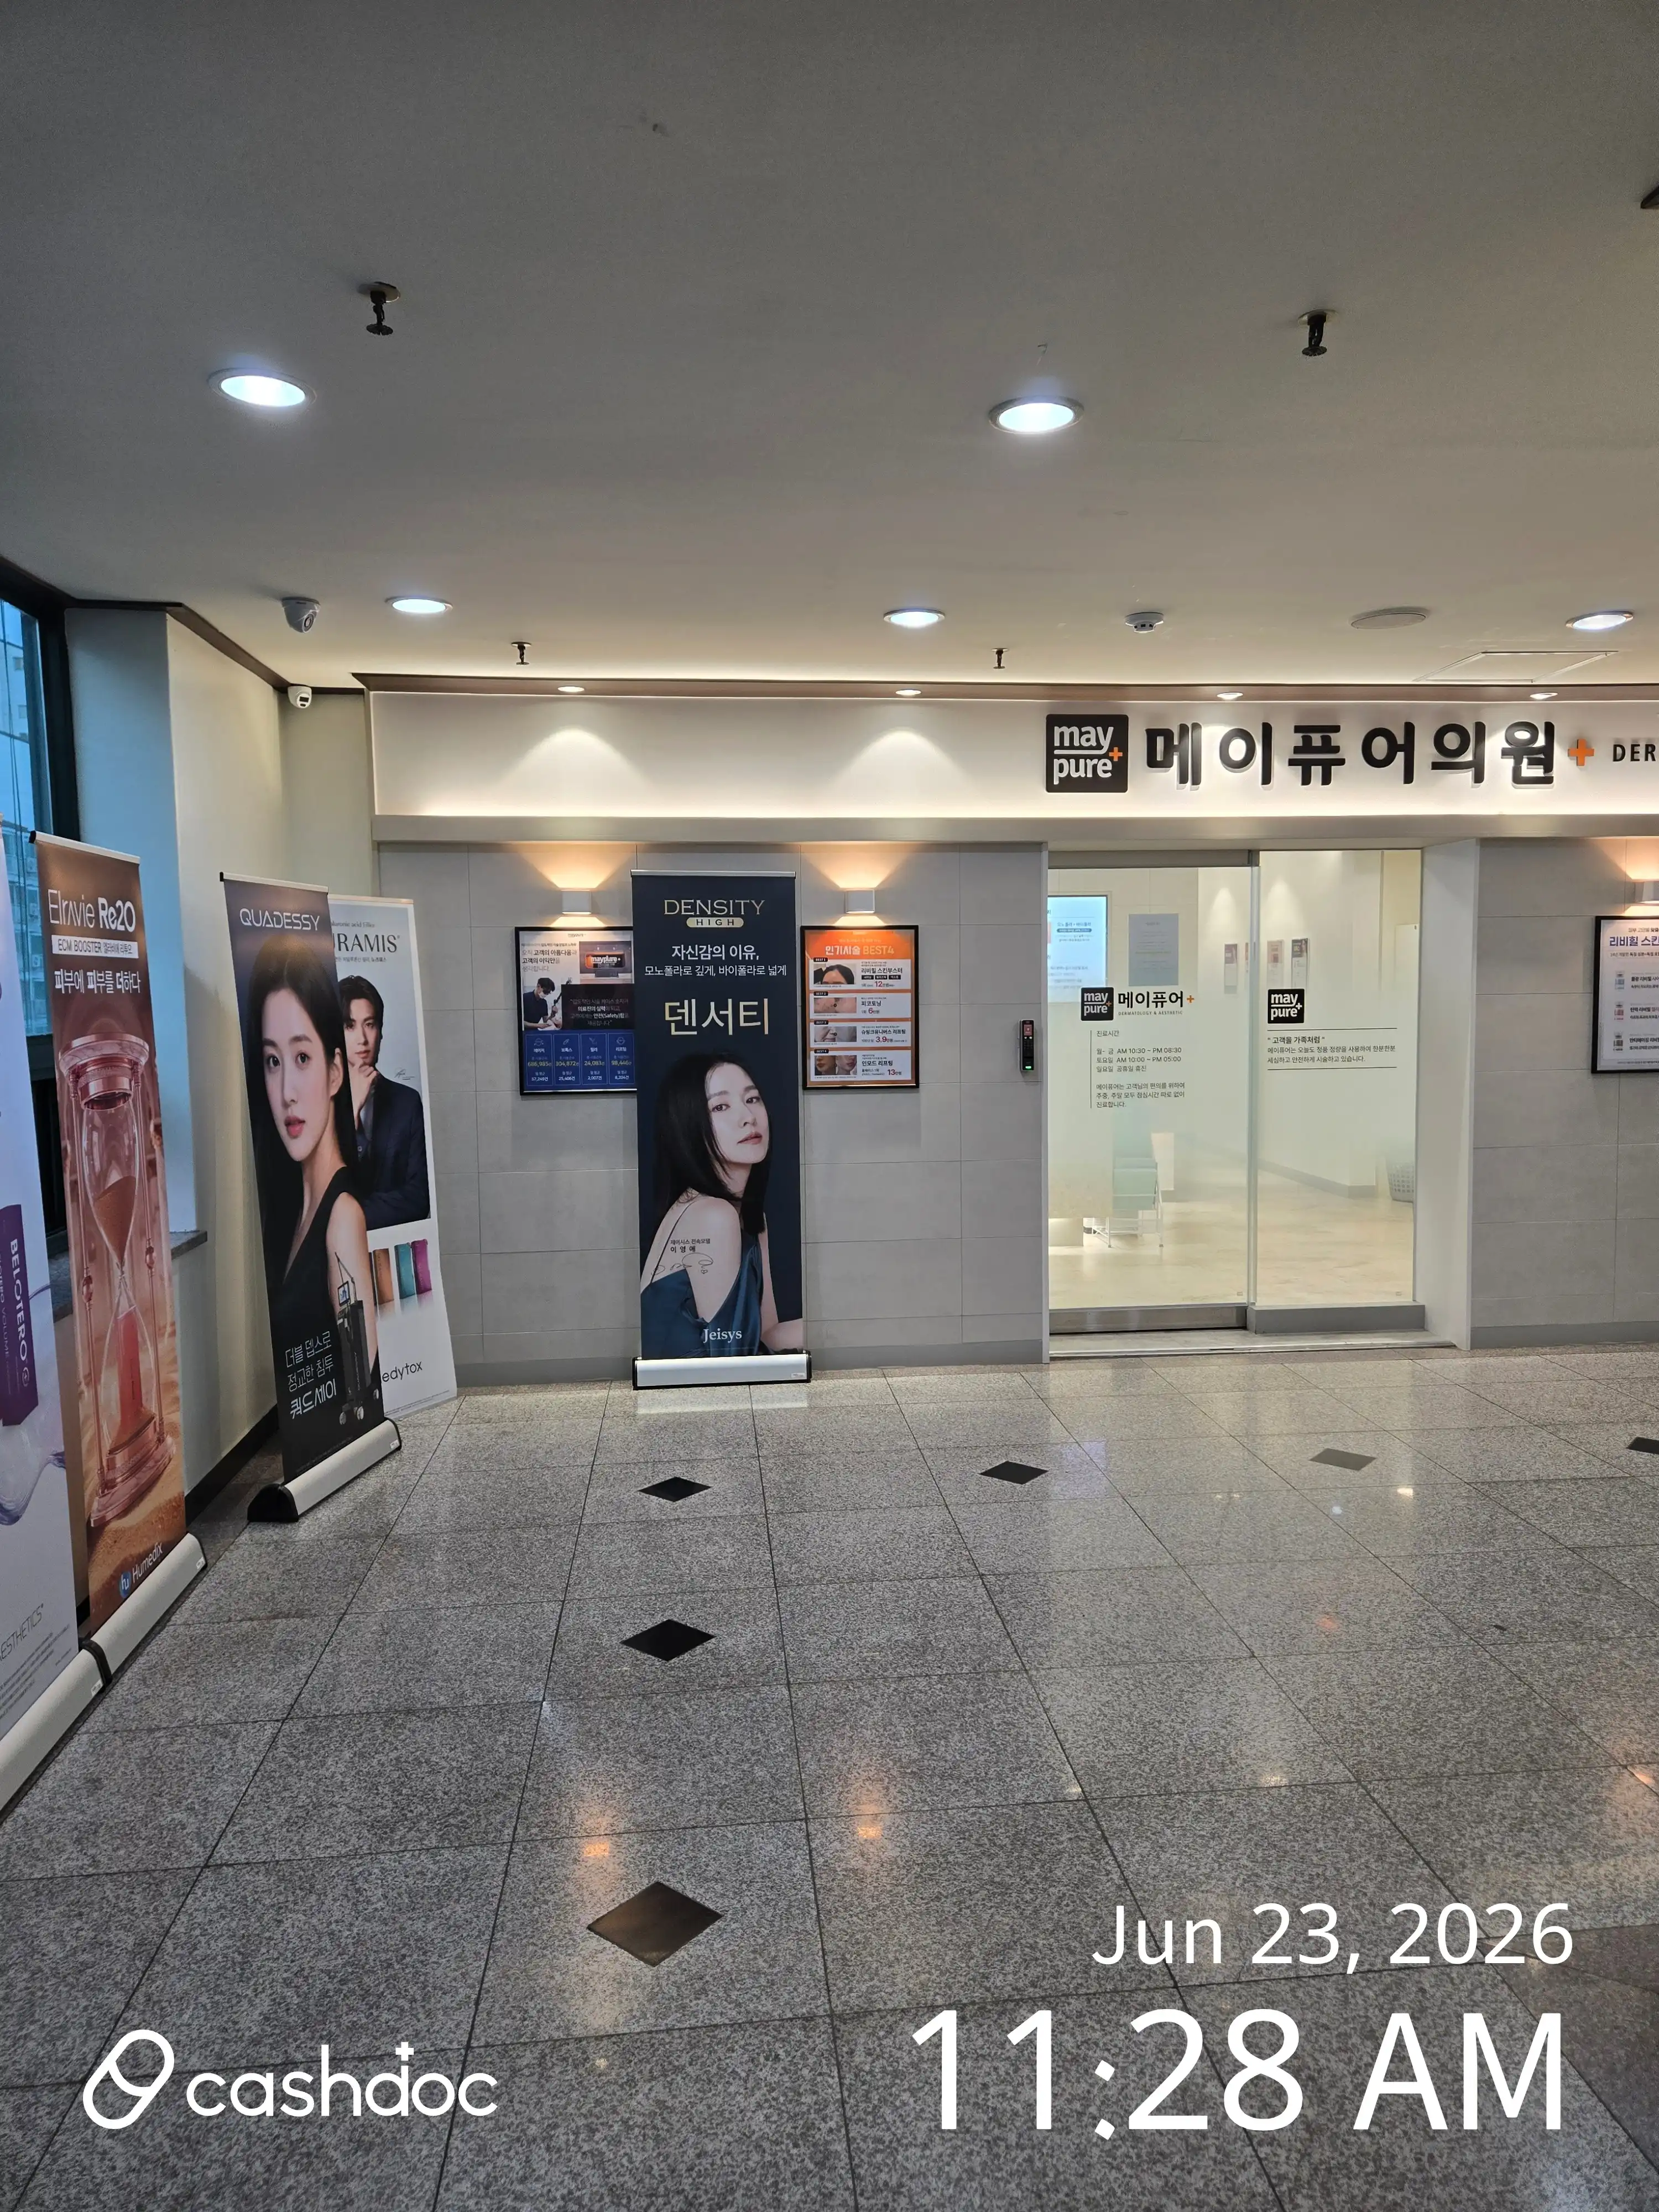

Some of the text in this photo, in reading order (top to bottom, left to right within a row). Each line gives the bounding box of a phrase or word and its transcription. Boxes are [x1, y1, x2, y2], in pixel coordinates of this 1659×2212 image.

[1054, 726, 1114, 754] may
[1145, 721, 1657, 786] 메이퓨어의원 DER
[1054, 758, 1113, 785] pure
[48, 889, 95, 928] Elravie
[664, 899, 765, 915] DENSITY
[239, 908, 320, 931] QUADESSY
[58, 938, 72, 951] ECM
[74, 940, 102, 952] BOOSTER
[332, 933, 397, 953] RAMIS
[825, 946, 894, 956] 인기시술 BEST4
[1610, 936, 1638, 946] 리비힐
[671, 945, 759, 961] 자신감의 이유,
[54, 969, 141, 994] 피부에 피부를 더하다
[645, 965, 786, 976] 모노폴라로 깊게, 바이폴라로 넓게
[1084, 992, 1108, 1004] may
[1118, 990, 1183, 1009] 메이퓨어
[1271, 994, 1298, 1006] may
[665, 998, 769, 1035] 덴서티
[1084, 1006, 1108, 1016] pure
[1271, 1008, 1297, 1020] pure
[10, 1239, 27, 1360] BELOTERO
[703, 1328, 742, 1343] Jeisys
[285, 1331, 332, 1368] 더블 뎁스로
[288, 1367, 314, 1392] 정교한
[316, 1354, 334, 1378] 침투
[382, 1361, 423, 1383] edytox
[290, 1379, 337, 1419] 쿼드세이
[132, 1542, 163, 1584] Humedix
[0, 1605, 43, 1661] ESTHETICS
